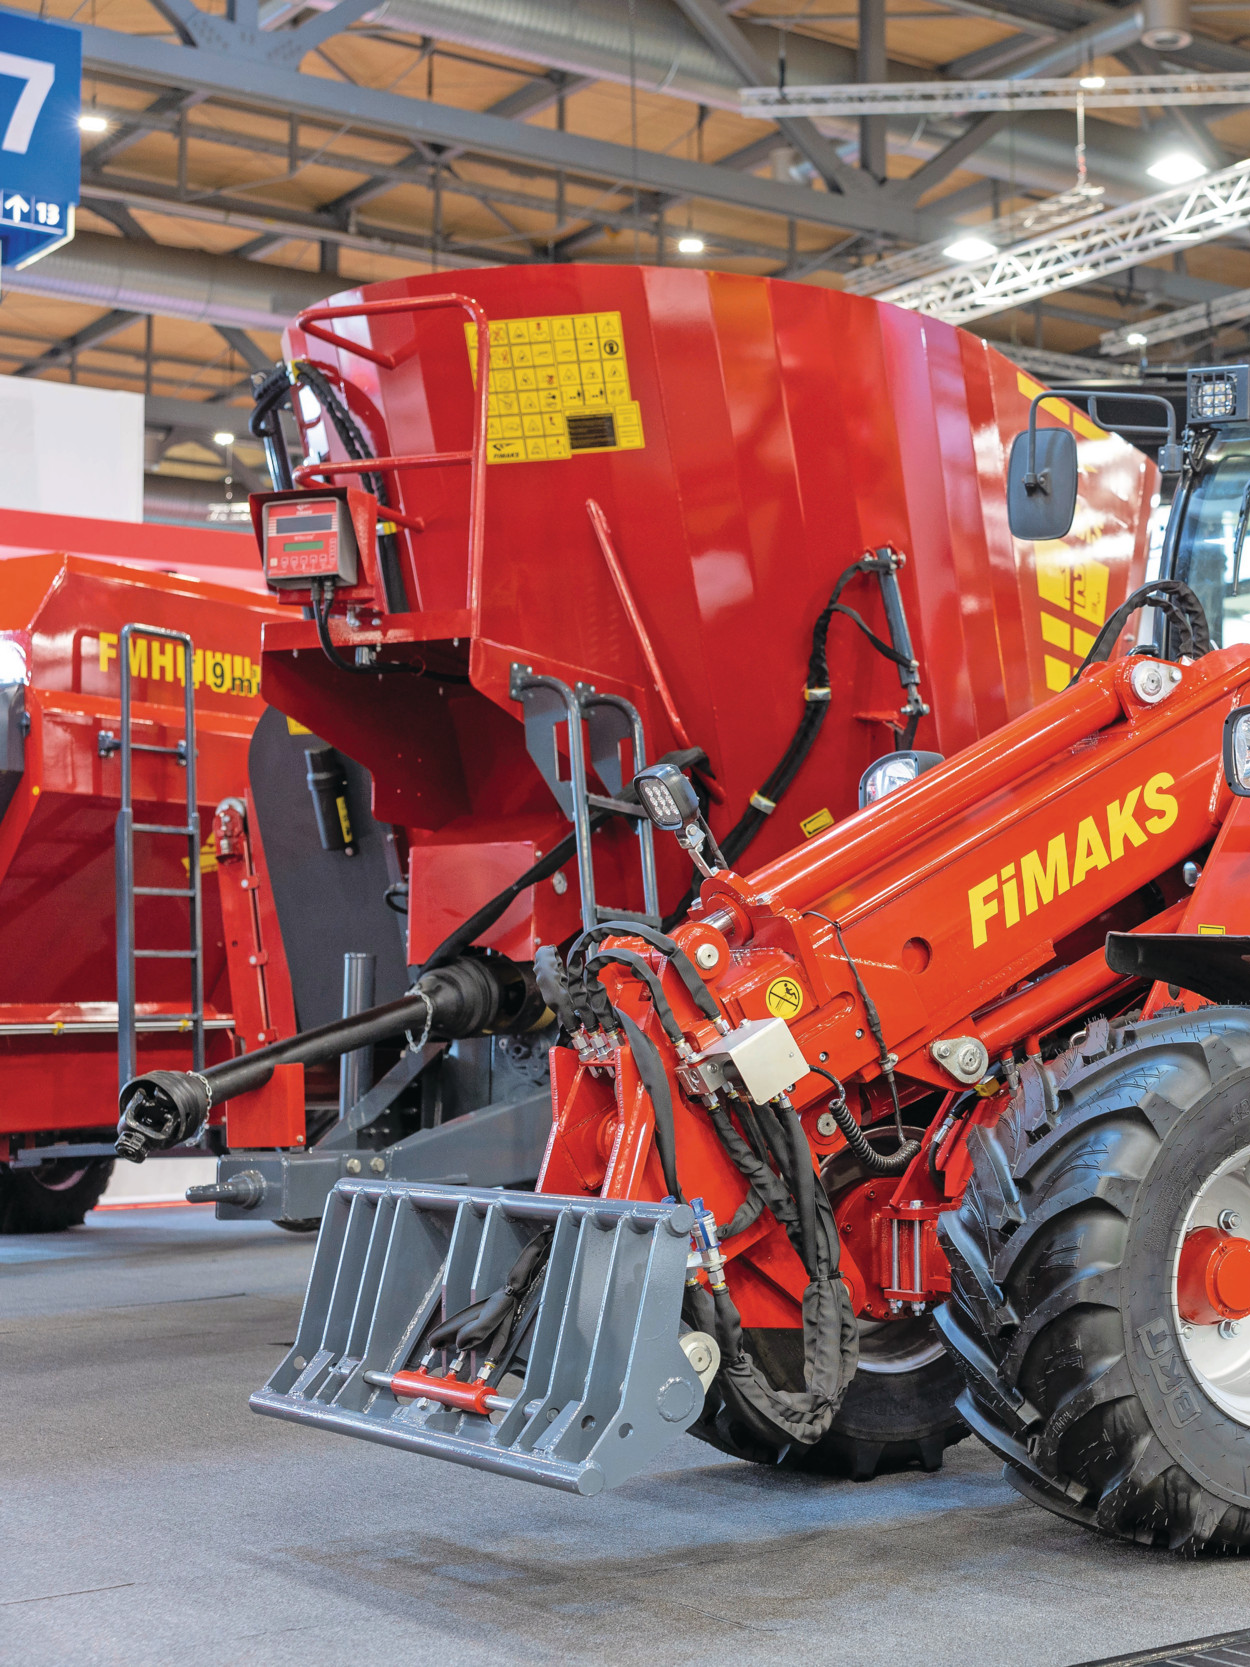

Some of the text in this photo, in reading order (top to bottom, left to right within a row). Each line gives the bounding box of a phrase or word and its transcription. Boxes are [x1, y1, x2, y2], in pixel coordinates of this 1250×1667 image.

[0, 51, 56, 155] 7
[36, 202, 60, 225] 13
[1145, 1327, 1192, 1424] BKT
